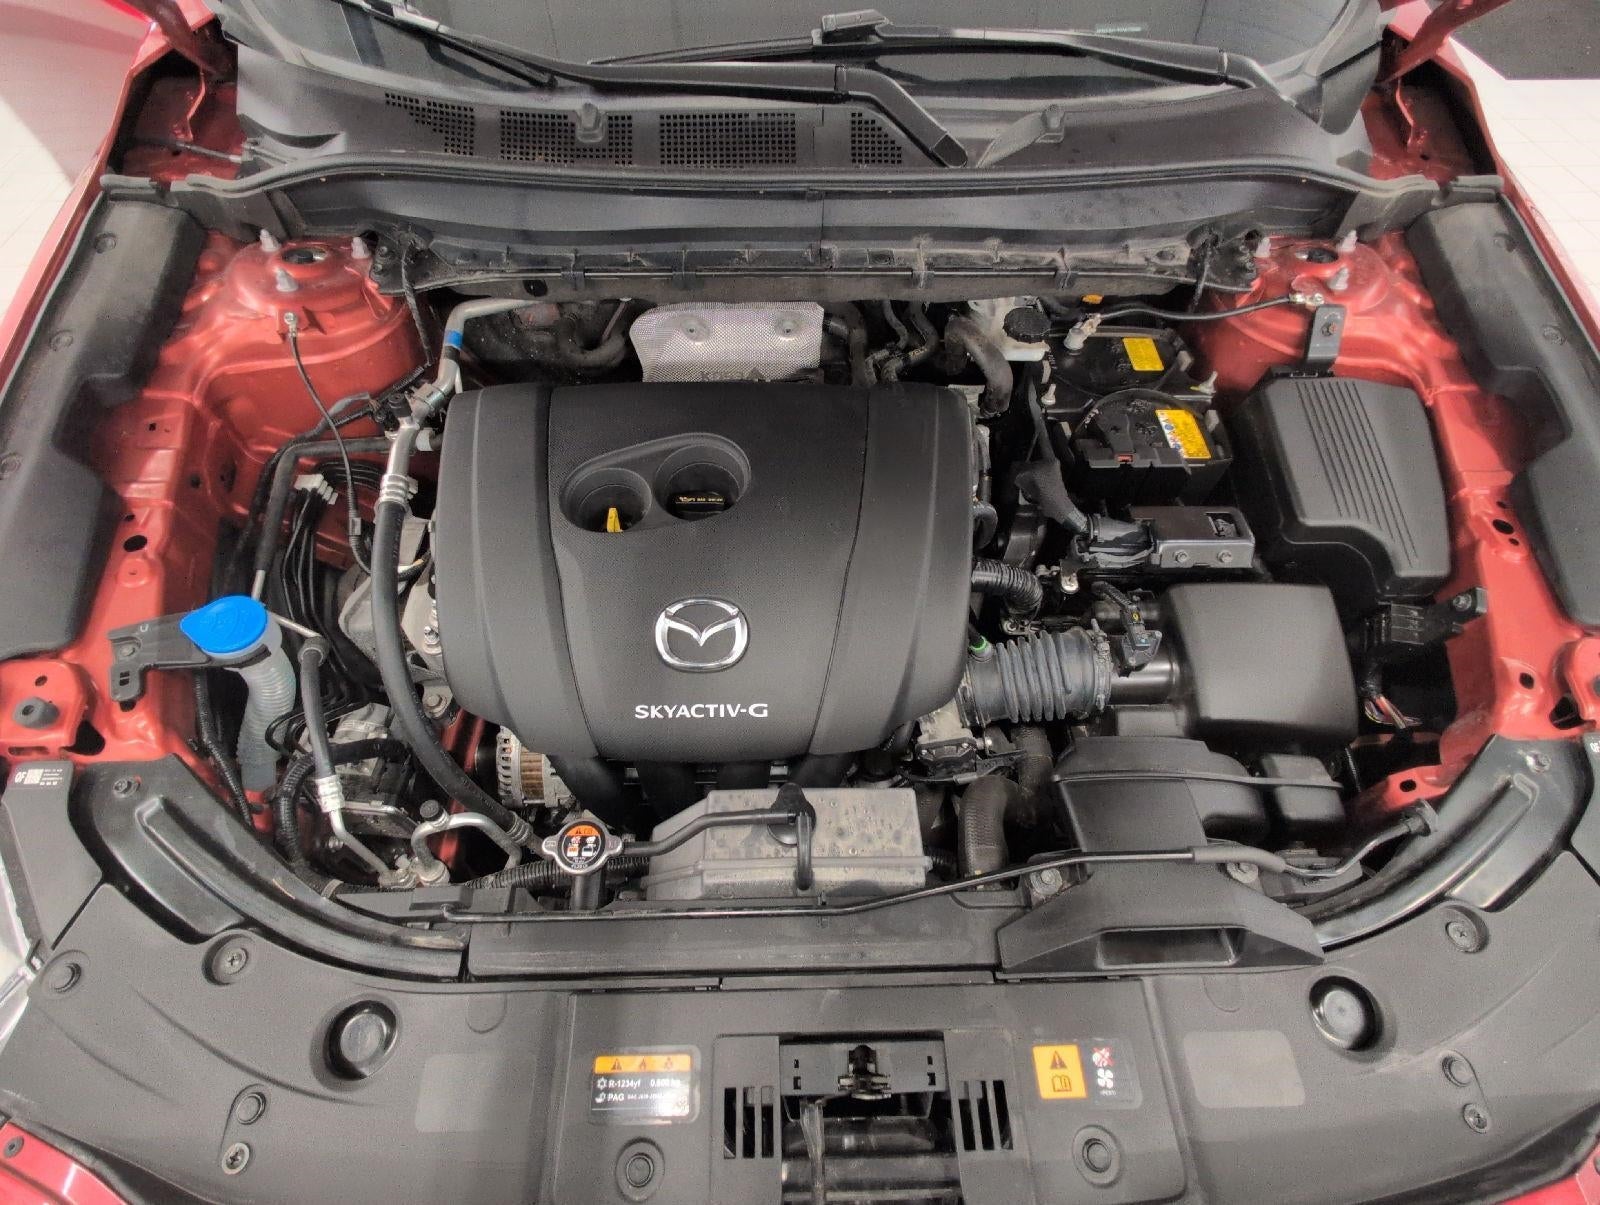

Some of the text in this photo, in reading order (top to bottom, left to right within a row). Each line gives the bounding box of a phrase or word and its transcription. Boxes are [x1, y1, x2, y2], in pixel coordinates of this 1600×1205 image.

[634, 703, 769, 719] SKYACTIV-G
[608, 1078, 641, 1089] R-1234yf
[608, 1093, 625, 1102] PAG
